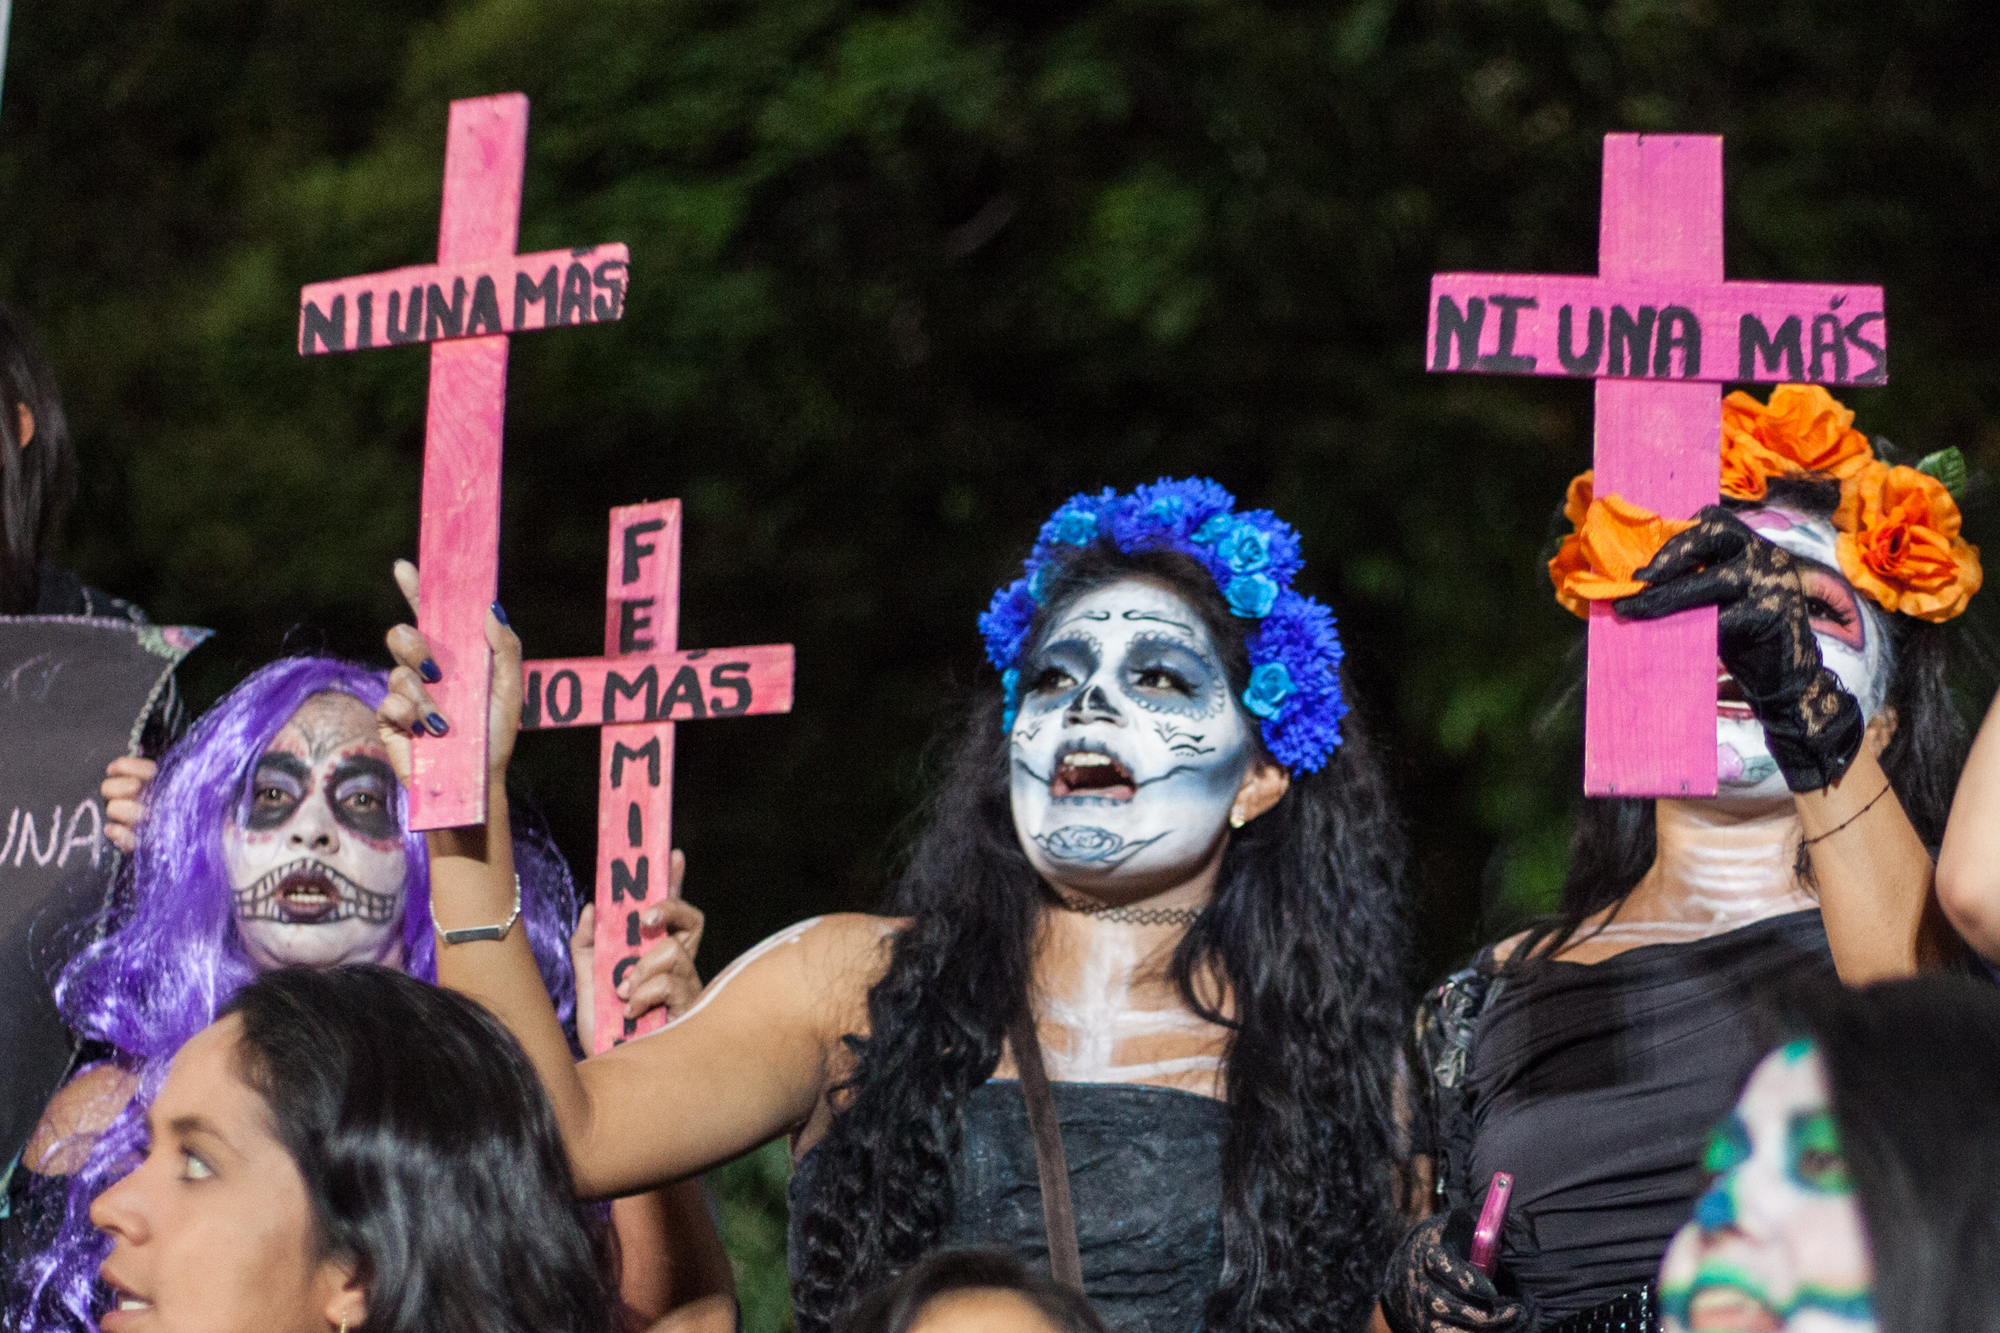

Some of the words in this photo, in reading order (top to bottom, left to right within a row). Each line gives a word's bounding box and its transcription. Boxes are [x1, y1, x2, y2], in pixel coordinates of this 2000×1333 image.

[301, 292, 373, 354] NI
[388, 275, 503, 342] UNA
[1433, 295, 1538, 371] NI
[1558, 303, 1701, 378] UNA
[1738, 294, 1887, 381] MÁS
[602, 650, 753, 721] MÁS
[610, 518, 666, 1045] FEMINI
